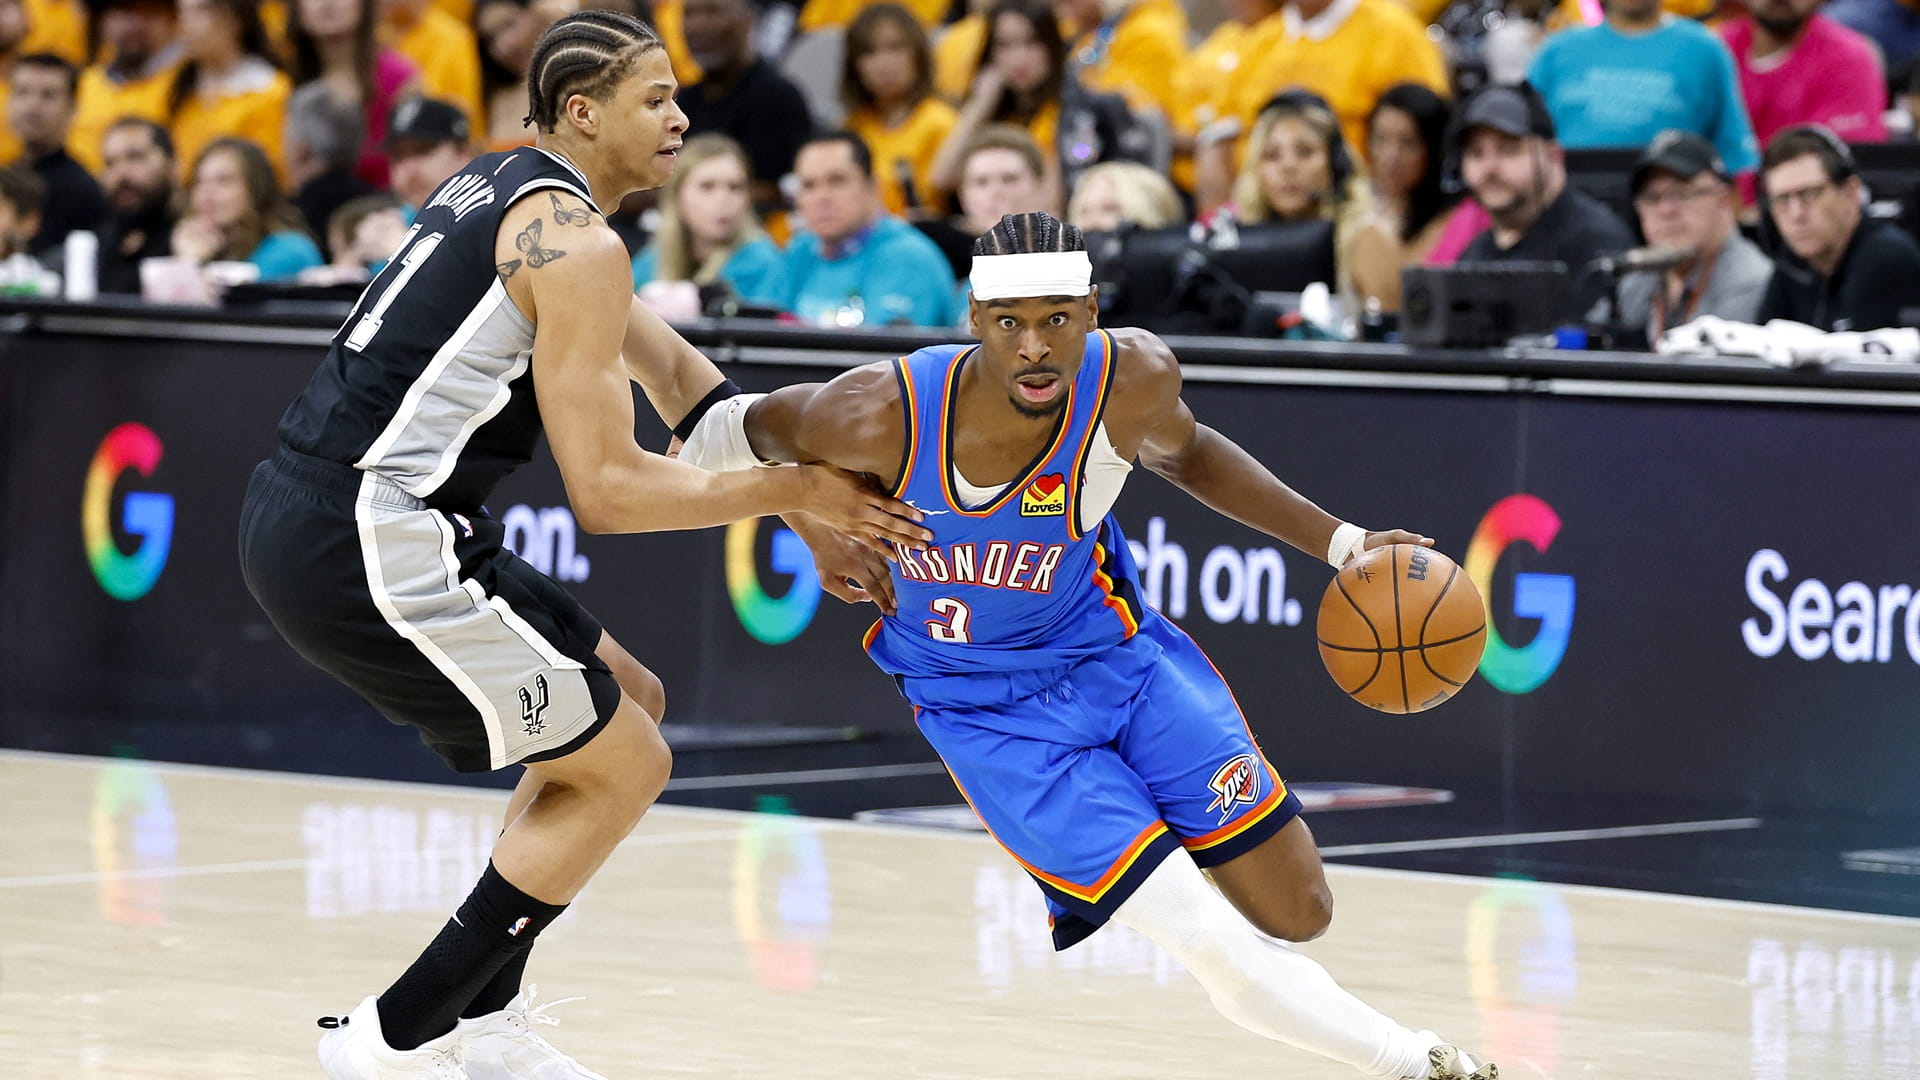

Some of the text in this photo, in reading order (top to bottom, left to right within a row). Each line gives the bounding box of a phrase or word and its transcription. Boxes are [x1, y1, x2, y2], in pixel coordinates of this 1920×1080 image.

[81, 421, 175, 602] G
[1199, 544, 1303, 627] on.
[1463, 493, 1576, 694] G
[1222, 762, 1249, 811] OKC
